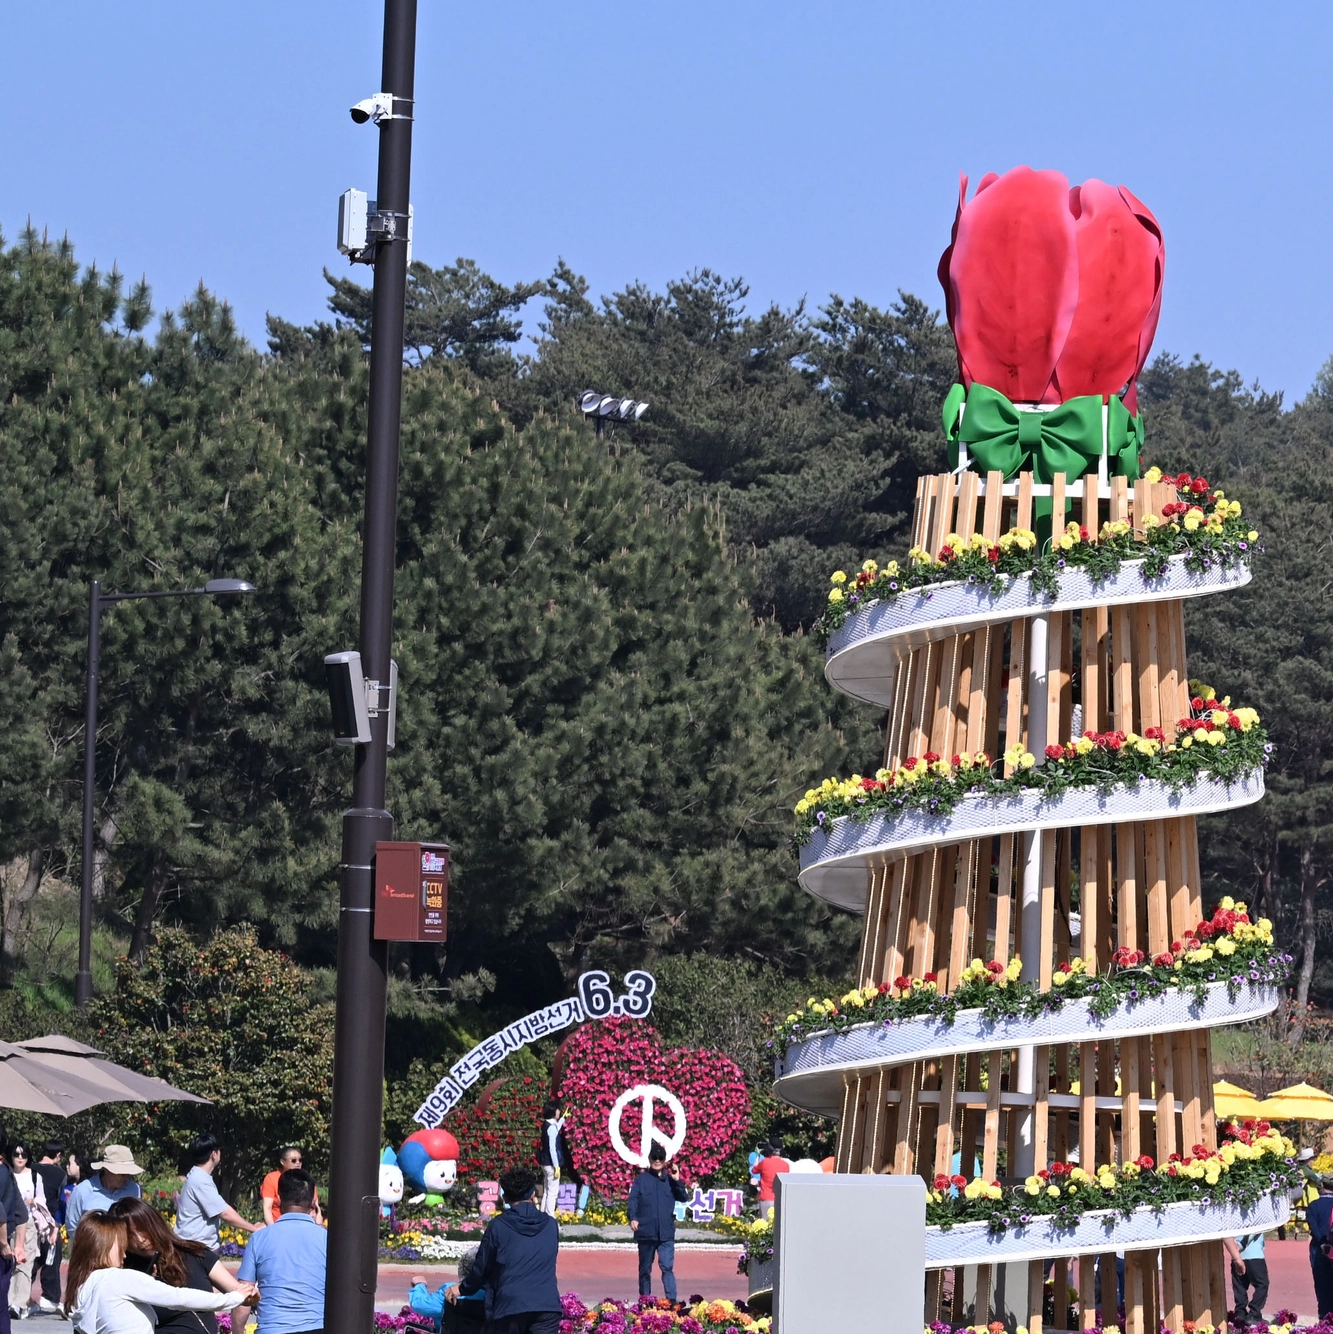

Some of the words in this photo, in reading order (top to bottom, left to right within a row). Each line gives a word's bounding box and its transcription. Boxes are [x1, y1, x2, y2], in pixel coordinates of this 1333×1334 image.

[427, 882, 443, 894] CCTV
[416, 1081, 462, 1129] 제9회
[452, 1000, 584, 1085] 전국동시지방선거
[581, 971, 655, 1017] 6.3
